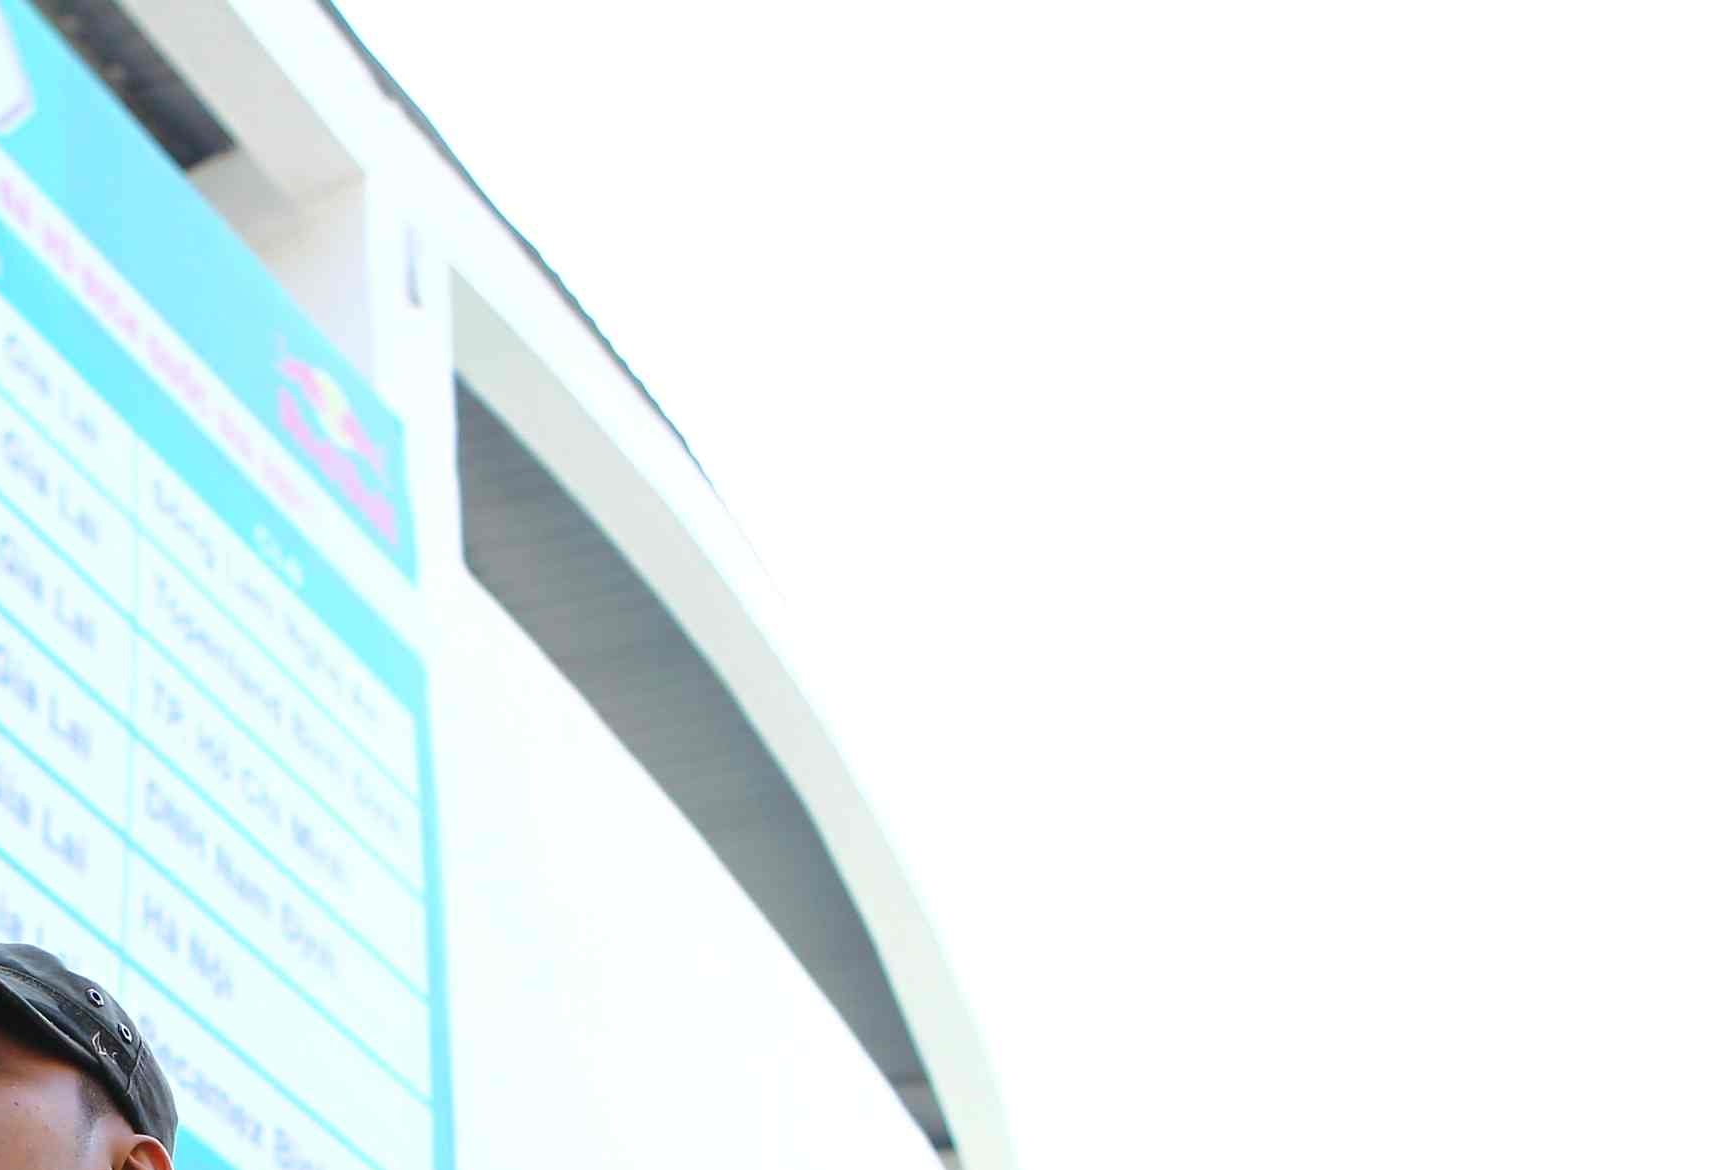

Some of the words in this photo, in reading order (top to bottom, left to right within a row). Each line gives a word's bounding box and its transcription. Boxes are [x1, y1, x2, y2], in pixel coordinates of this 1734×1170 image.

[0, 428, 50, 497] Gia
[53, 588, 98, 650] Lai
[47, 690, 91, 758] Lai
[40, 808, 86, 870] Lai
